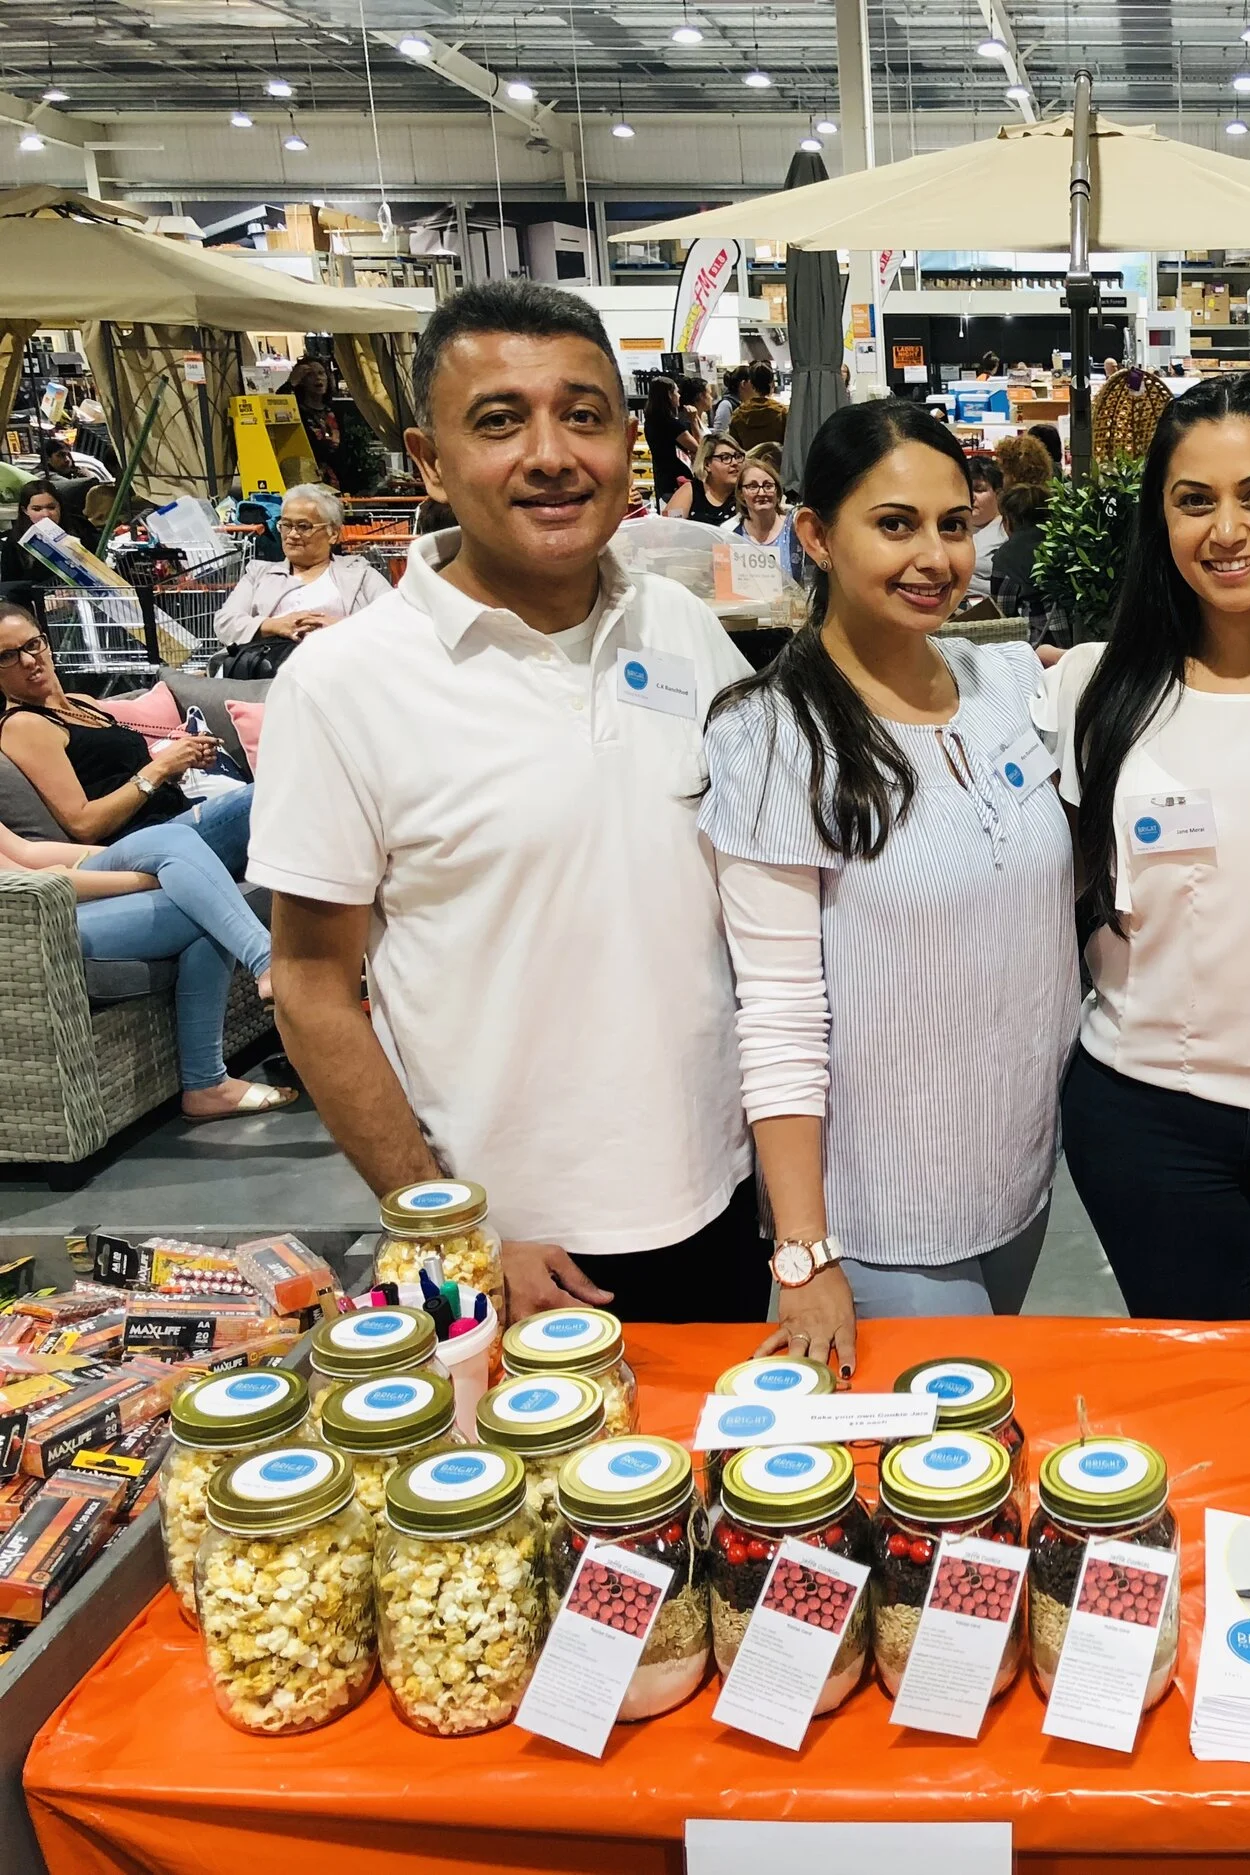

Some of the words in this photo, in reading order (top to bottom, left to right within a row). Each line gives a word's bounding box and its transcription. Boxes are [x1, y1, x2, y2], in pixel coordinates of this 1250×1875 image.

[734, 552, 776, 569] $1699
[134, 1293, 193, 1301] MAXLIFE
[129, 1324, 181, 1338] MAXLIFE
[197, 1321, 211, 1329] AA
[361, 1320, 397, 1330] BRIGHT
[548, 1323, 585, 1332] BRIGHT
[195, 1332, 209, 1340] 20
[212, 1357, 246, 1373] MAXLIFE
[760, 1374, 796, 1384] BRIGHT
[235, 1382, 274, 1392] BRIGHT
[371, 1391, 410, 1401] BRIGHT
[725, 1413, 768, 1427] BRIGHT
[105, 1424, 118, 1435] 20
[48, 1429, 93, 1462] MAXLIFE
[104, 1411, 117, 1423] AA
[619, 1453, 651, 1471] BRIGHT
[772, 1456, 809, 1470] BRIGHT
[928, 1452, 965, 1464] BRIGHT
[1085, 1458, 1122, 1470] BRIGHT
[270, 1461, 311, 1473] BRIGHT
[440, 1463, 480, 1474] BRIGHT
